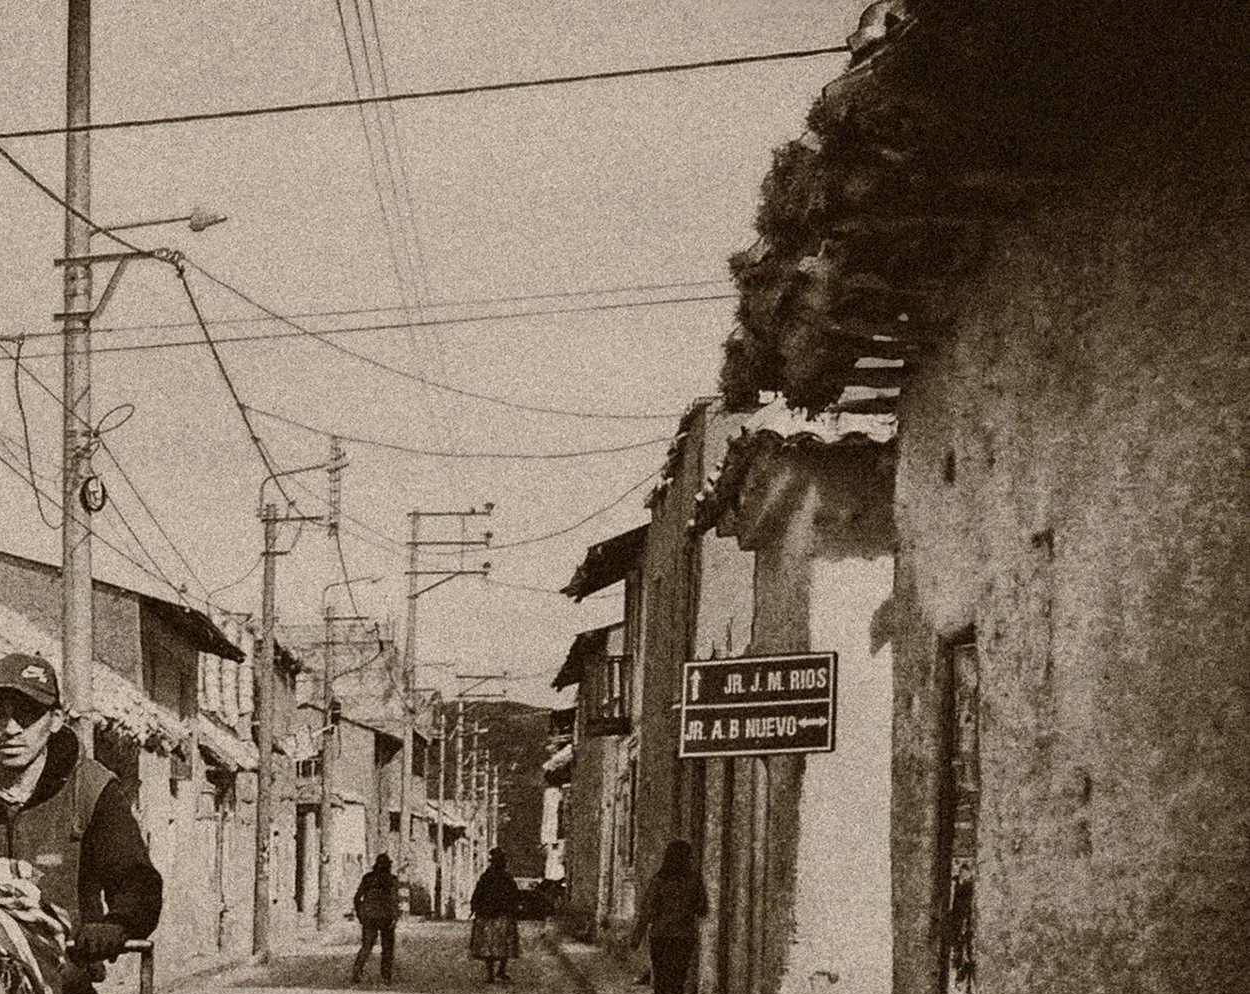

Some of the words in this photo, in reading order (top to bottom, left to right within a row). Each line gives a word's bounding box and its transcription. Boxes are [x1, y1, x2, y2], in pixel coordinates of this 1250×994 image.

[724, 674, 746, 694] JR.
[750, 672, 763, 692] J.
[767, 671, 785, 691] M.
[790, 667, 827, 690] RIOS
[685, 720, 707, 741] JR.
[711, 719, 726, 740] A.
[729, 719, 740, 739] B
[745, 715, 798, 739] NUEVO
